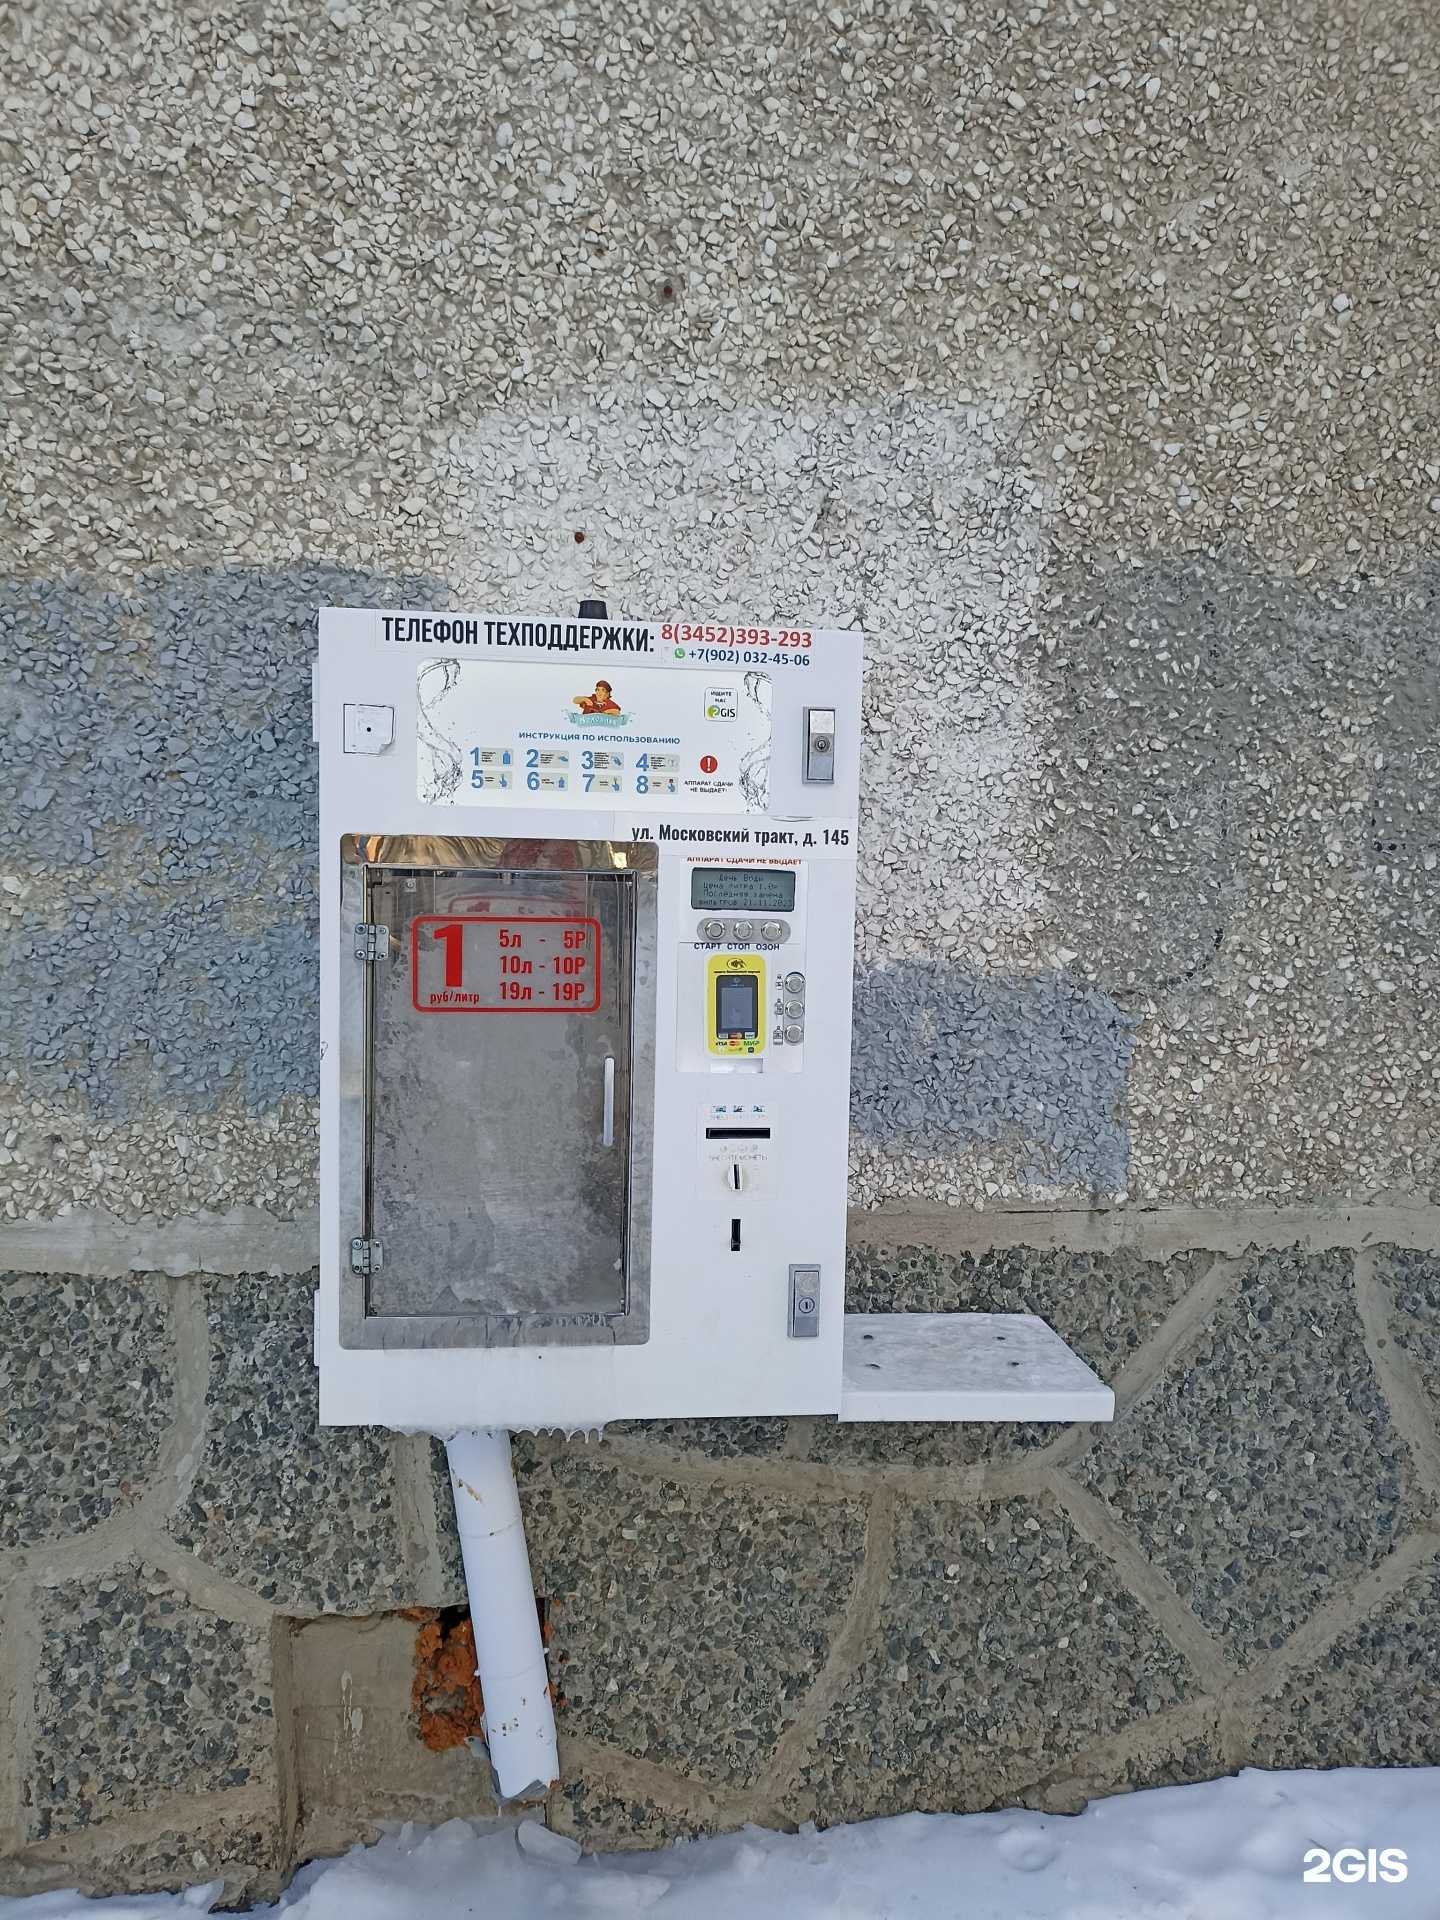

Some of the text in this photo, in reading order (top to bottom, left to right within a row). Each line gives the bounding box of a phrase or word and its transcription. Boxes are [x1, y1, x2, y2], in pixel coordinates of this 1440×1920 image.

[382, 617, 655, 652] ТЕЛЕФОН ТЕХПОДДЕРЖКИ:
[661, 624, 812, 648] 8(3452)393-293
[689, 648, 810, 666] +7(902) 032-45-06
[518, 732, 580, 741] ИНСТРУКЦИЯ
[597, 735, 681, 745] ИСПОЛЬЗОВАНИЮ
[470, 747, 480, 766] 1
[526, 749, 539, 768] 2
[581, 751, 594, 770] 3
[636, 753, 649, 771] 4
[471, 770, 484, 788] 5
[527, 772, 540, 790] 6
[582, 774, 595, 792] 7
[637, 775, 649, 794] 8
[632, 824, 849, 847] ул. Московский тракт, д. 145
[499, 930, 522, 947] 5л
[563, 931, 586, 948] 5Р
[433, 924, 464, 987] 1
[500, 956, 533, 974] 10л
[553, 956, 586, 975] 10Р
[430, 991, 480, 1005] руб/литр
[500, 982, 532, 1000] 19л
[553, 983, 585, 1001] 19Р
